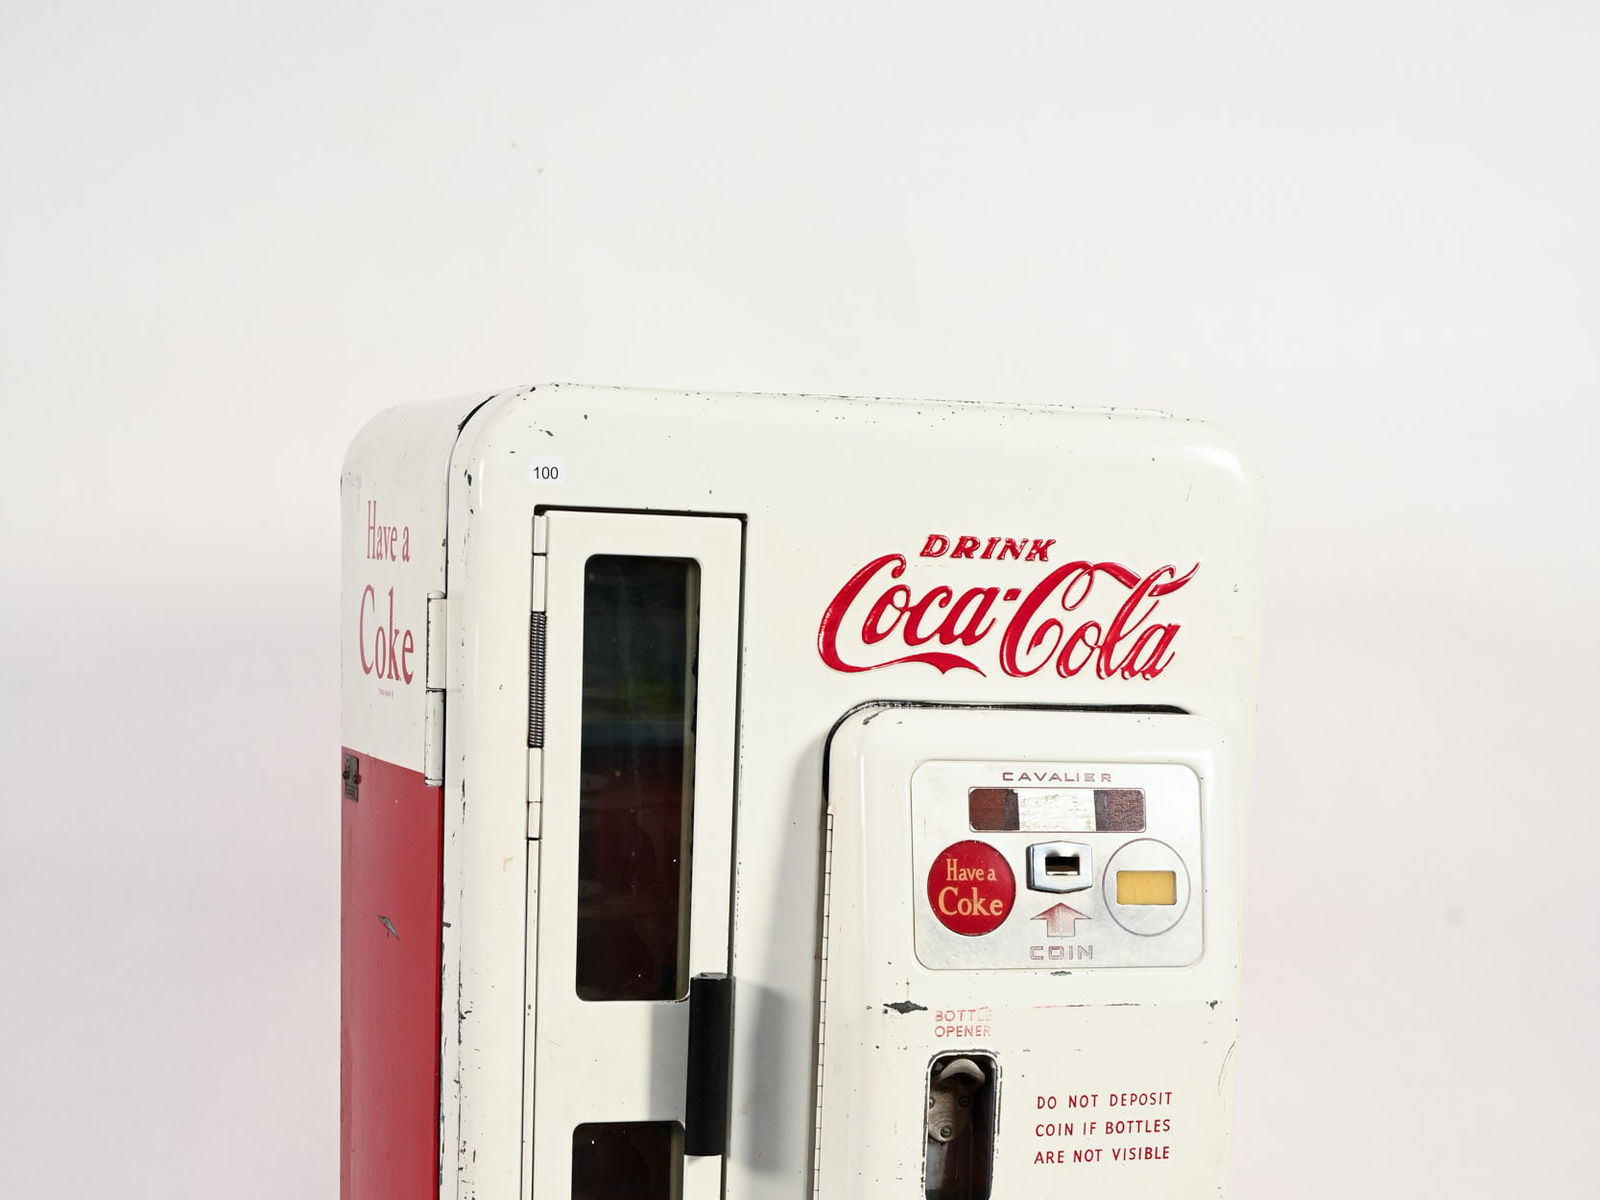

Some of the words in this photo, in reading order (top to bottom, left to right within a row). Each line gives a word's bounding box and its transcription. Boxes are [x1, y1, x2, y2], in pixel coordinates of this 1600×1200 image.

[533, 466, 559, 480] 100
[366, 500, 398, 562] Have
[402, 525, 411, 563] a
[919, 533, 1058, 562] DRINK
[817, 553, 1201, 681] Coca-Cola
[359, 584, 415, 685] Coke
[1002, 772, 1113, 783] CAVALIER
[945, 858, 984, 882] Have
[986, 867, 997, 882] a
[938, 886, 1004, 917] Coke
[1029, 944, 1094, 961] COIN
[934, 1025, 992, 1038] OPENER
[1036, 1095, 1057, 1110] DO
[1068, 1094, 1099, 1109] NOT
[1109, 1091, 1173, 1107] DEPOSIT
[1035, 1122, 1074, 1137] COIN
[1082, 1121, 1097, 1136] IF
[1105, 1119, 1171, 1135] BOTTLES
[1033, 1150, 1065, 1165] ARE
[1073, 1148, 1103, 1163] NOT
[1111, 1146, 1170, 1162] VISIBLE
